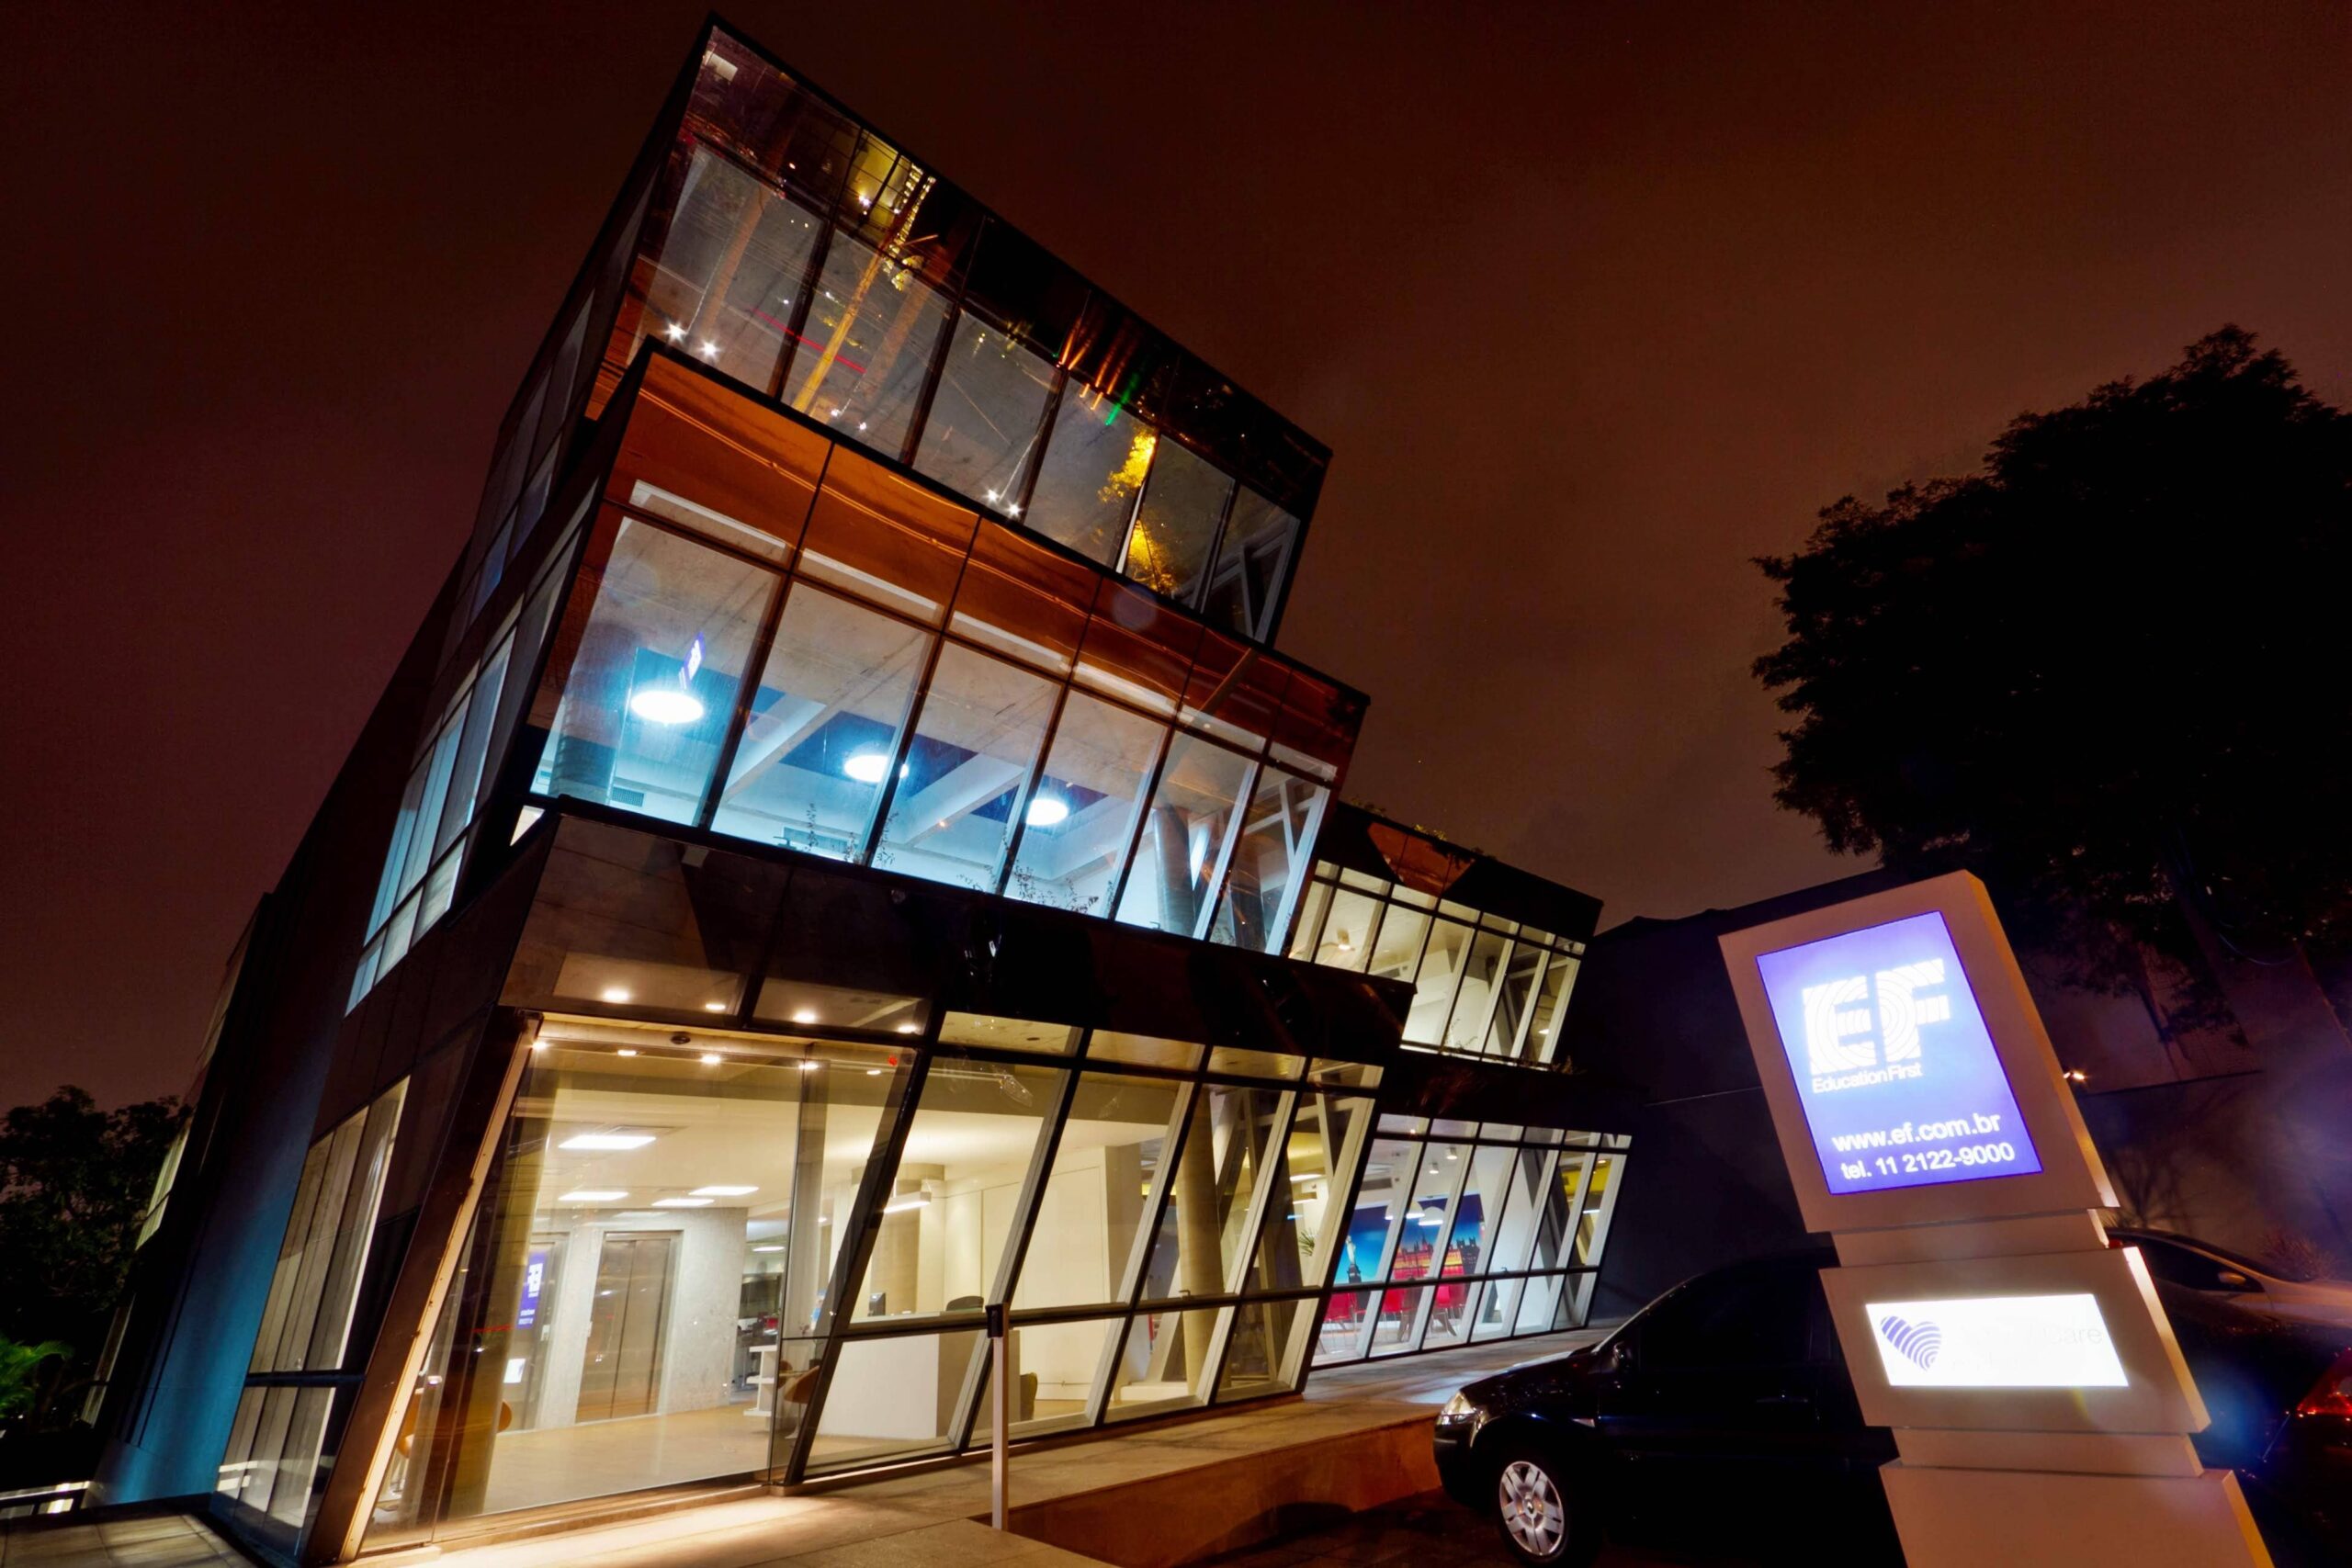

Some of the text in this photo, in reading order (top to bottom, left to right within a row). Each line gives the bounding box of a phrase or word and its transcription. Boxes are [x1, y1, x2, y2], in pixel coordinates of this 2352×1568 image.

[1802, 957, 1951, 1076] EF
[1832, 1112, 2001, 1152] www.ef.com.br
[1840, 1142, 2016, 1180] tel. 11 2122-9000
